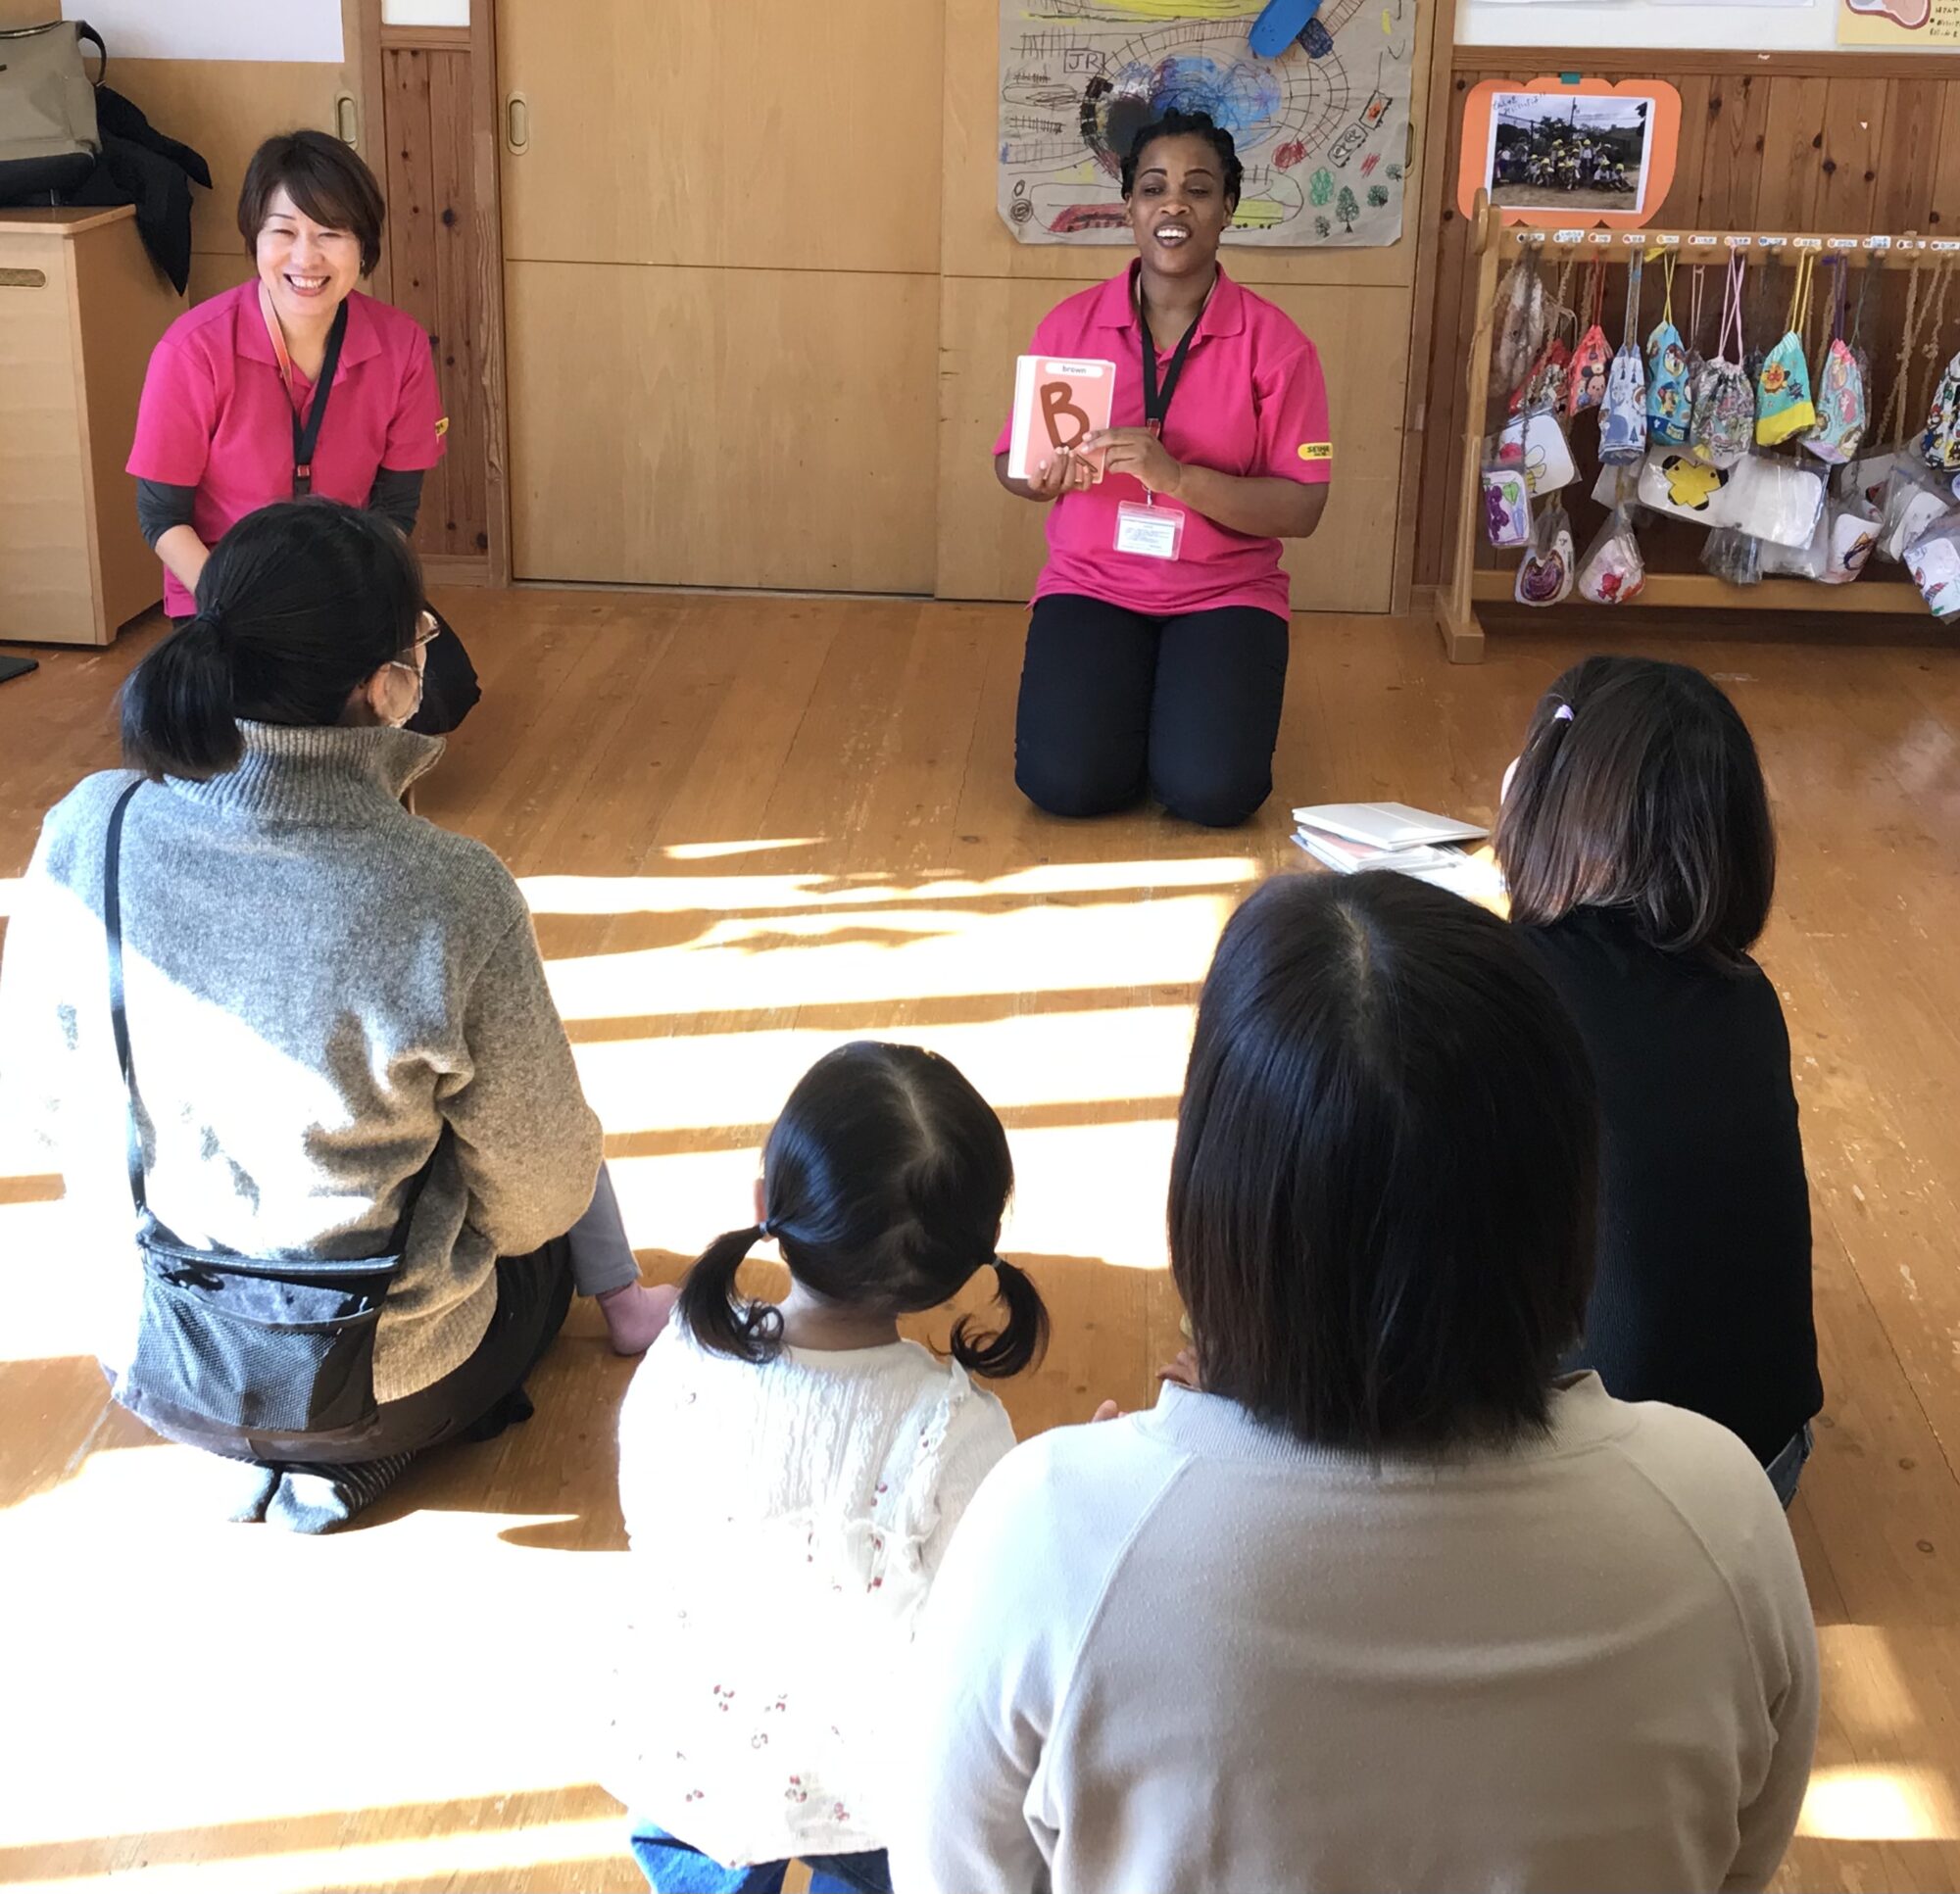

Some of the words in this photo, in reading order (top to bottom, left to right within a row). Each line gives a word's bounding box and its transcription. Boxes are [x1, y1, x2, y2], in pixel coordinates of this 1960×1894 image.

[1068, 52, 1100, 70] JR
[1061, 364, 1087, 374] brown
[1040, 381, 1090, 451] B
